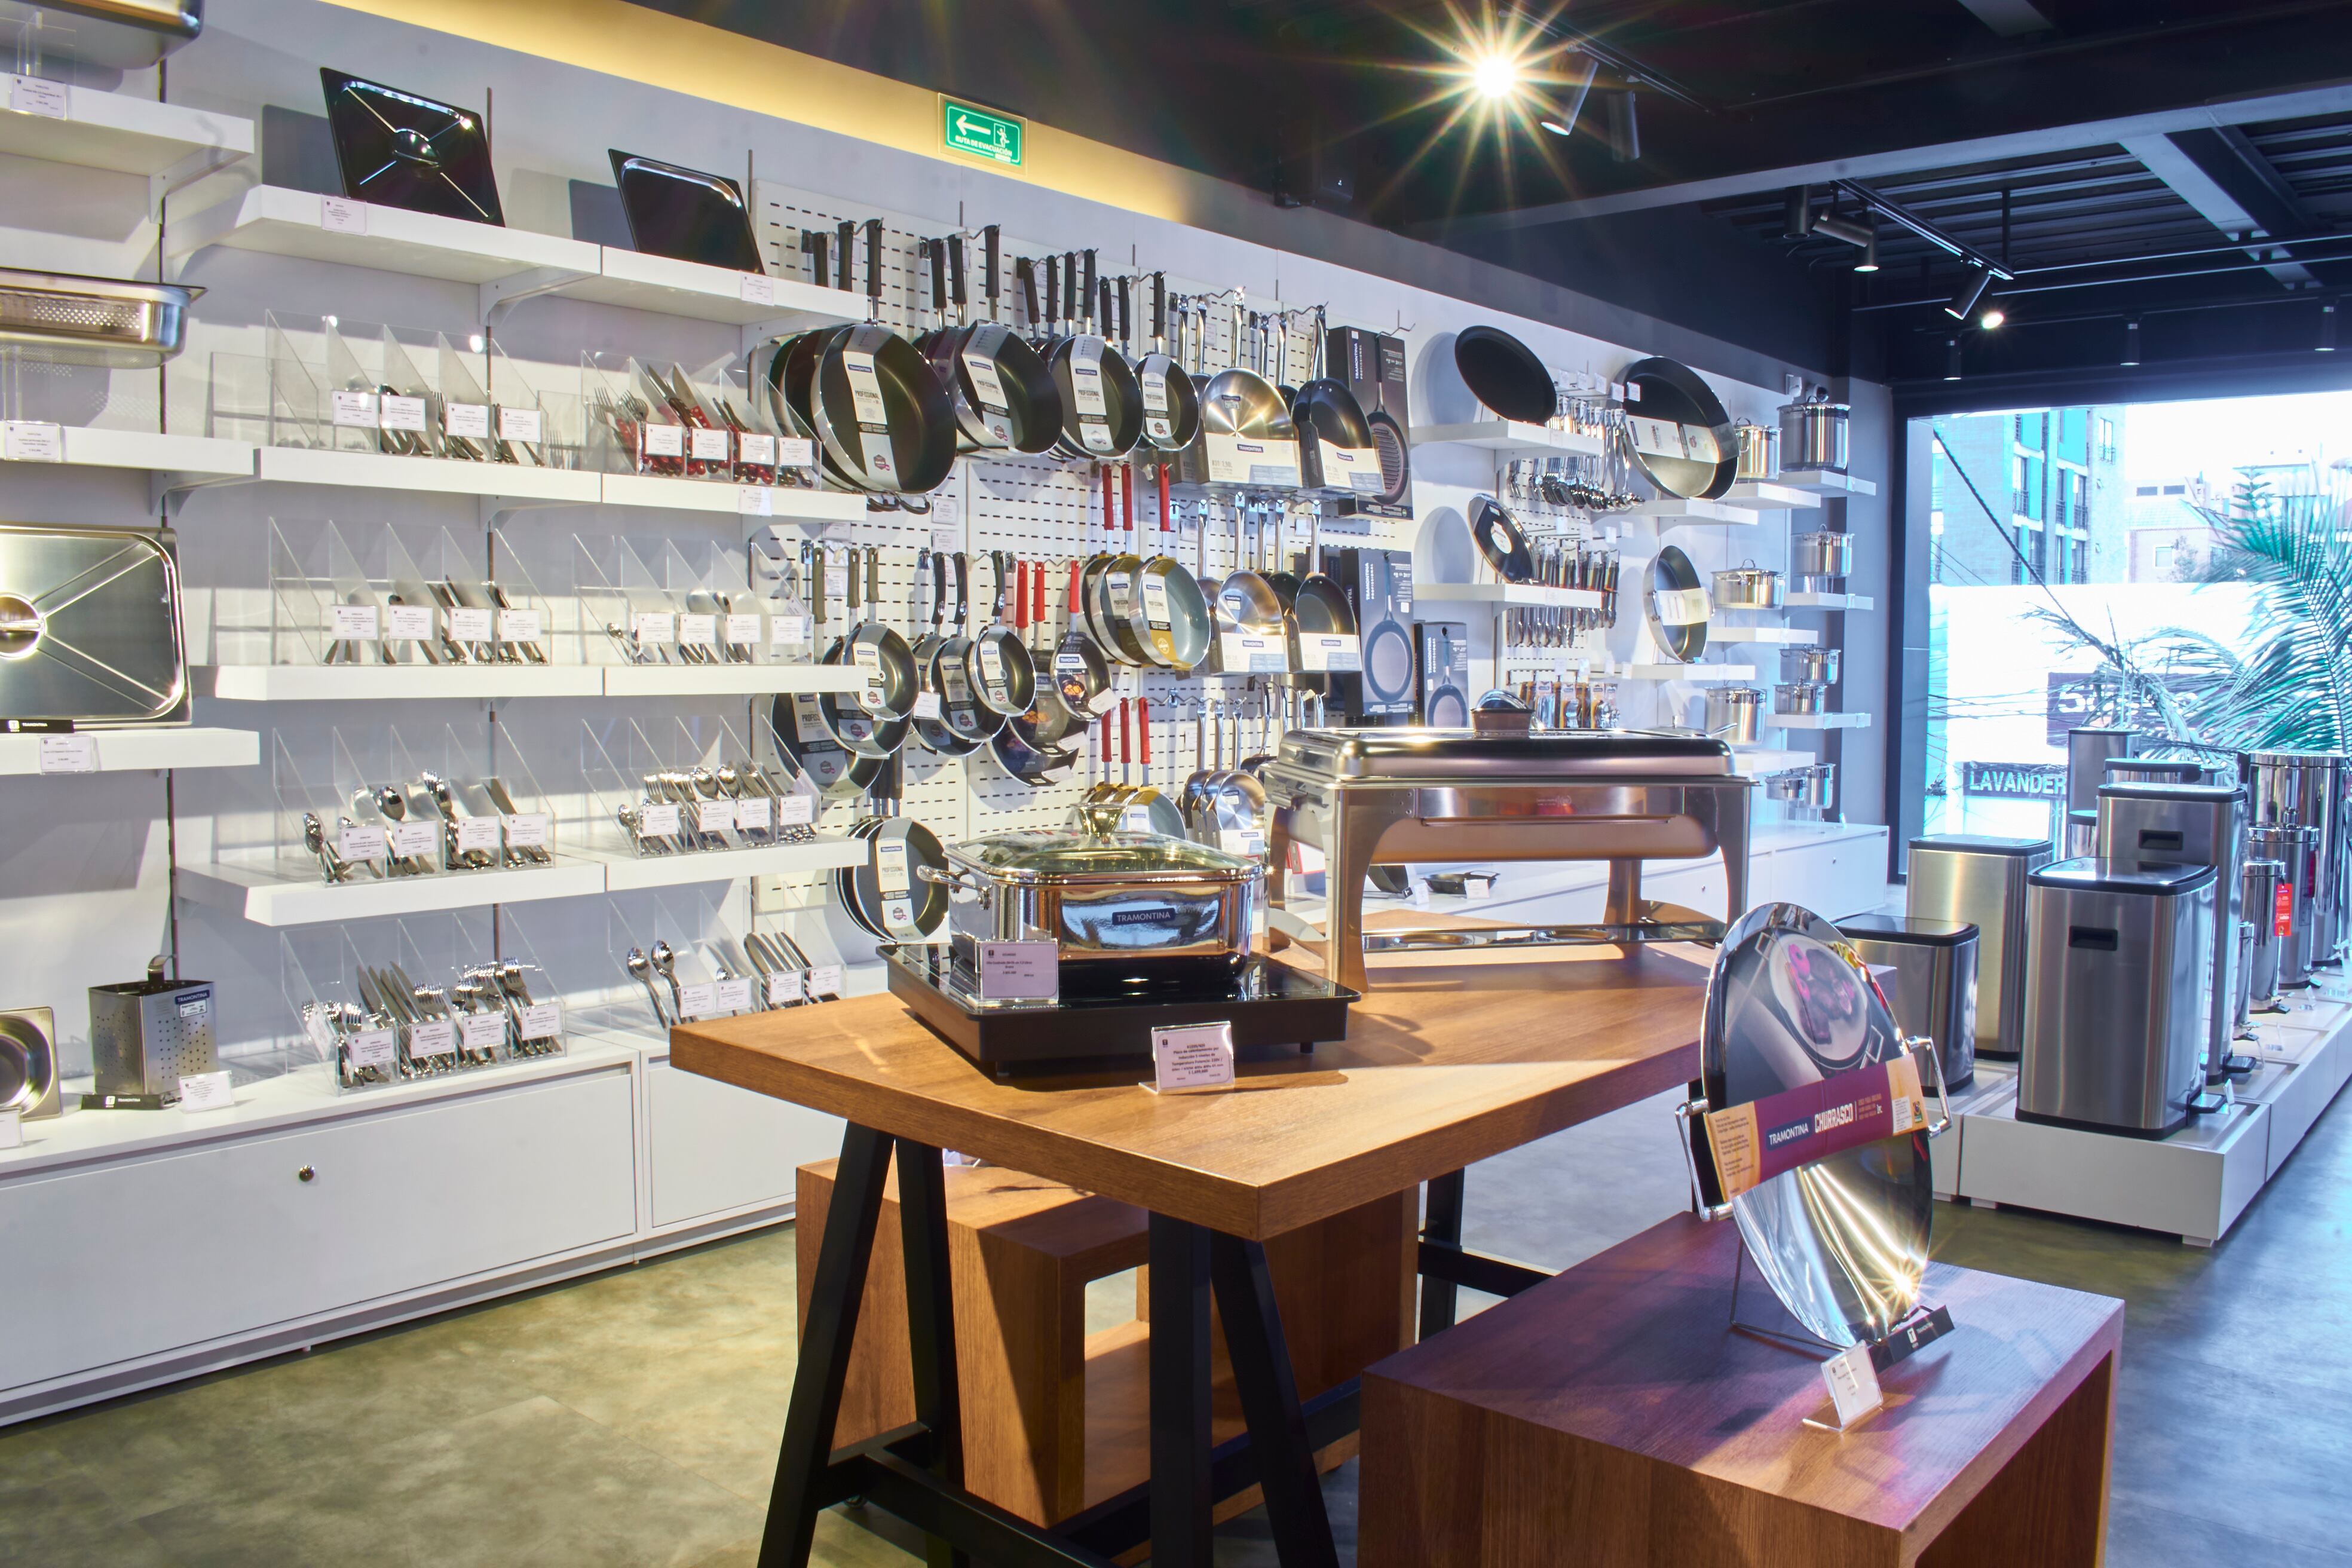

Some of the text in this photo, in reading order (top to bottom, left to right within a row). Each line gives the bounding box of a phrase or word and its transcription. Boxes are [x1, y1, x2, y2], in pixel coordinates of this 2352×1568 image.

[955, 135, 1013, 157] RUTA DE EVACUACIÓN
[1238, 445, 1263, 453] TRAMONTINA
[1116, 911, 1171, 922] TRAMONTINA
[177, 993, 208, 1003] TRAMONTINA
[1769, 1122, 1809, 1146] TRAMONTINA
[1814, 1102, 1854, 1134] CHURRASCO
